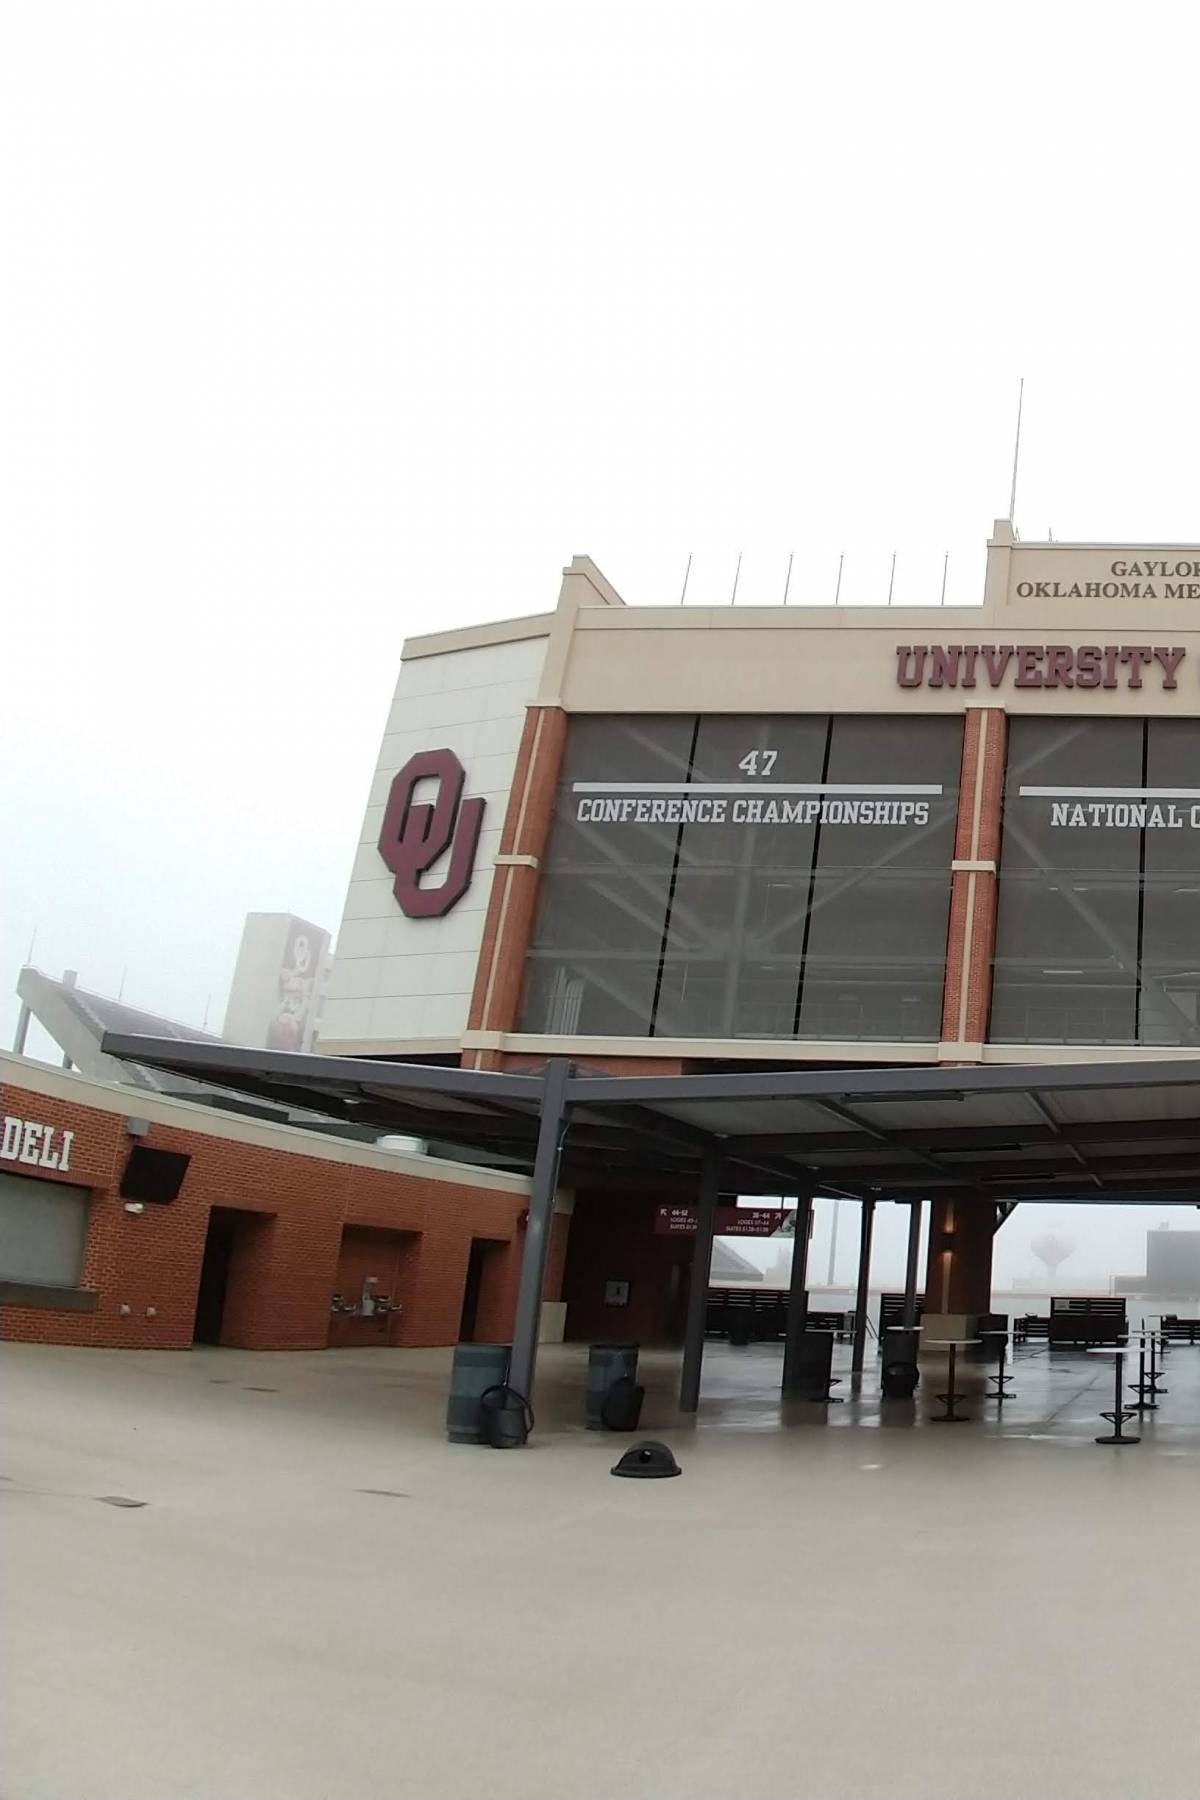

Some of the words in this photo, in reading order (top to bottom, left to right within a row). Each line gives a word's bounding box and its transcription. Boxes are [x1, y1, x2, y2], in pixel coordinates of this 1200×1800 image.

[1016, 581, 1157, 599] OKLAHOMA
[896, 644, 1187, 690] UNIVERSITY
[738, 750, 778, 776] 47
[577, 798, 727, 823] CONFERENCE
[732, 799, 930, 825] CHAMPIONSHIPS
[1050, 803, 1183, 829] NATIONAL
[377, 748, 488, 919] OU
[0, 1116, 74, 1172] DELI
